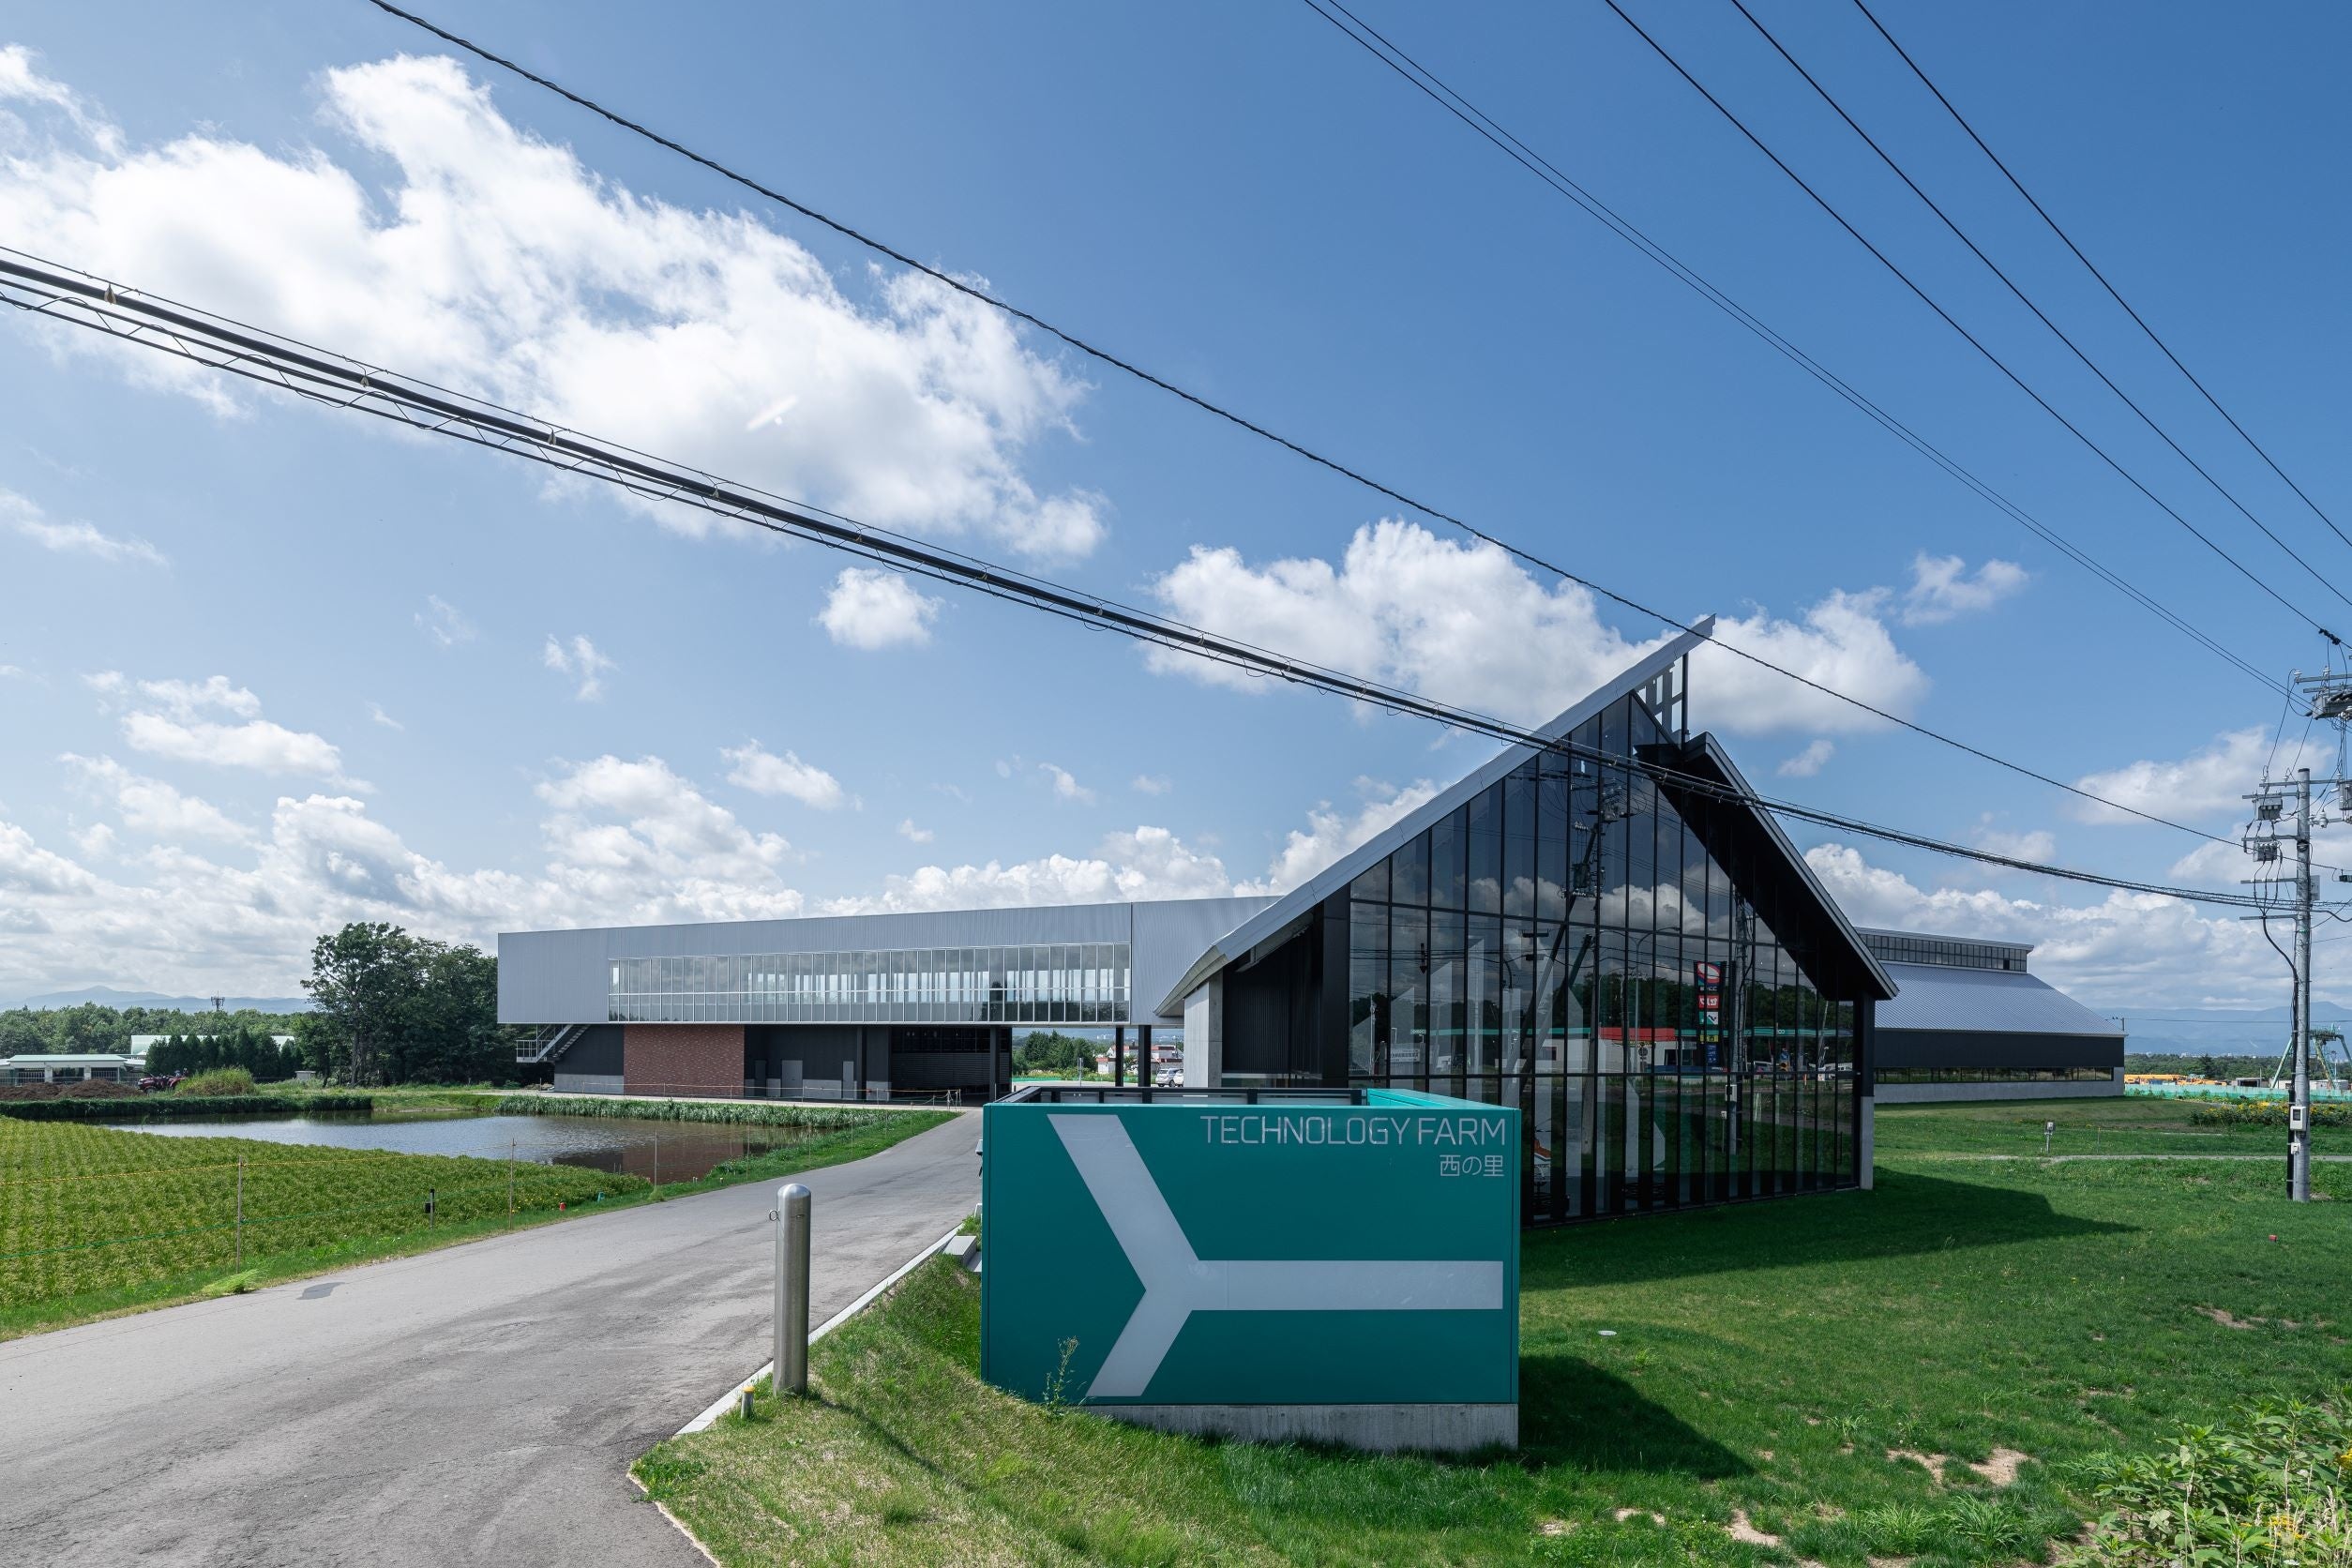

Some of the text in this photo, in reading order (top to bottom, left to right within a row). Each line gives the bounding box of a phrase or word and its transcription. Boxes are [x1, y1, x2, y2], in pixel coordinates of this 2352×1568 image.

[1199, 1115, 1505, 1145] TECHNOLOGY FARM
[1440, 1154, 1504, 1177] 西の里
